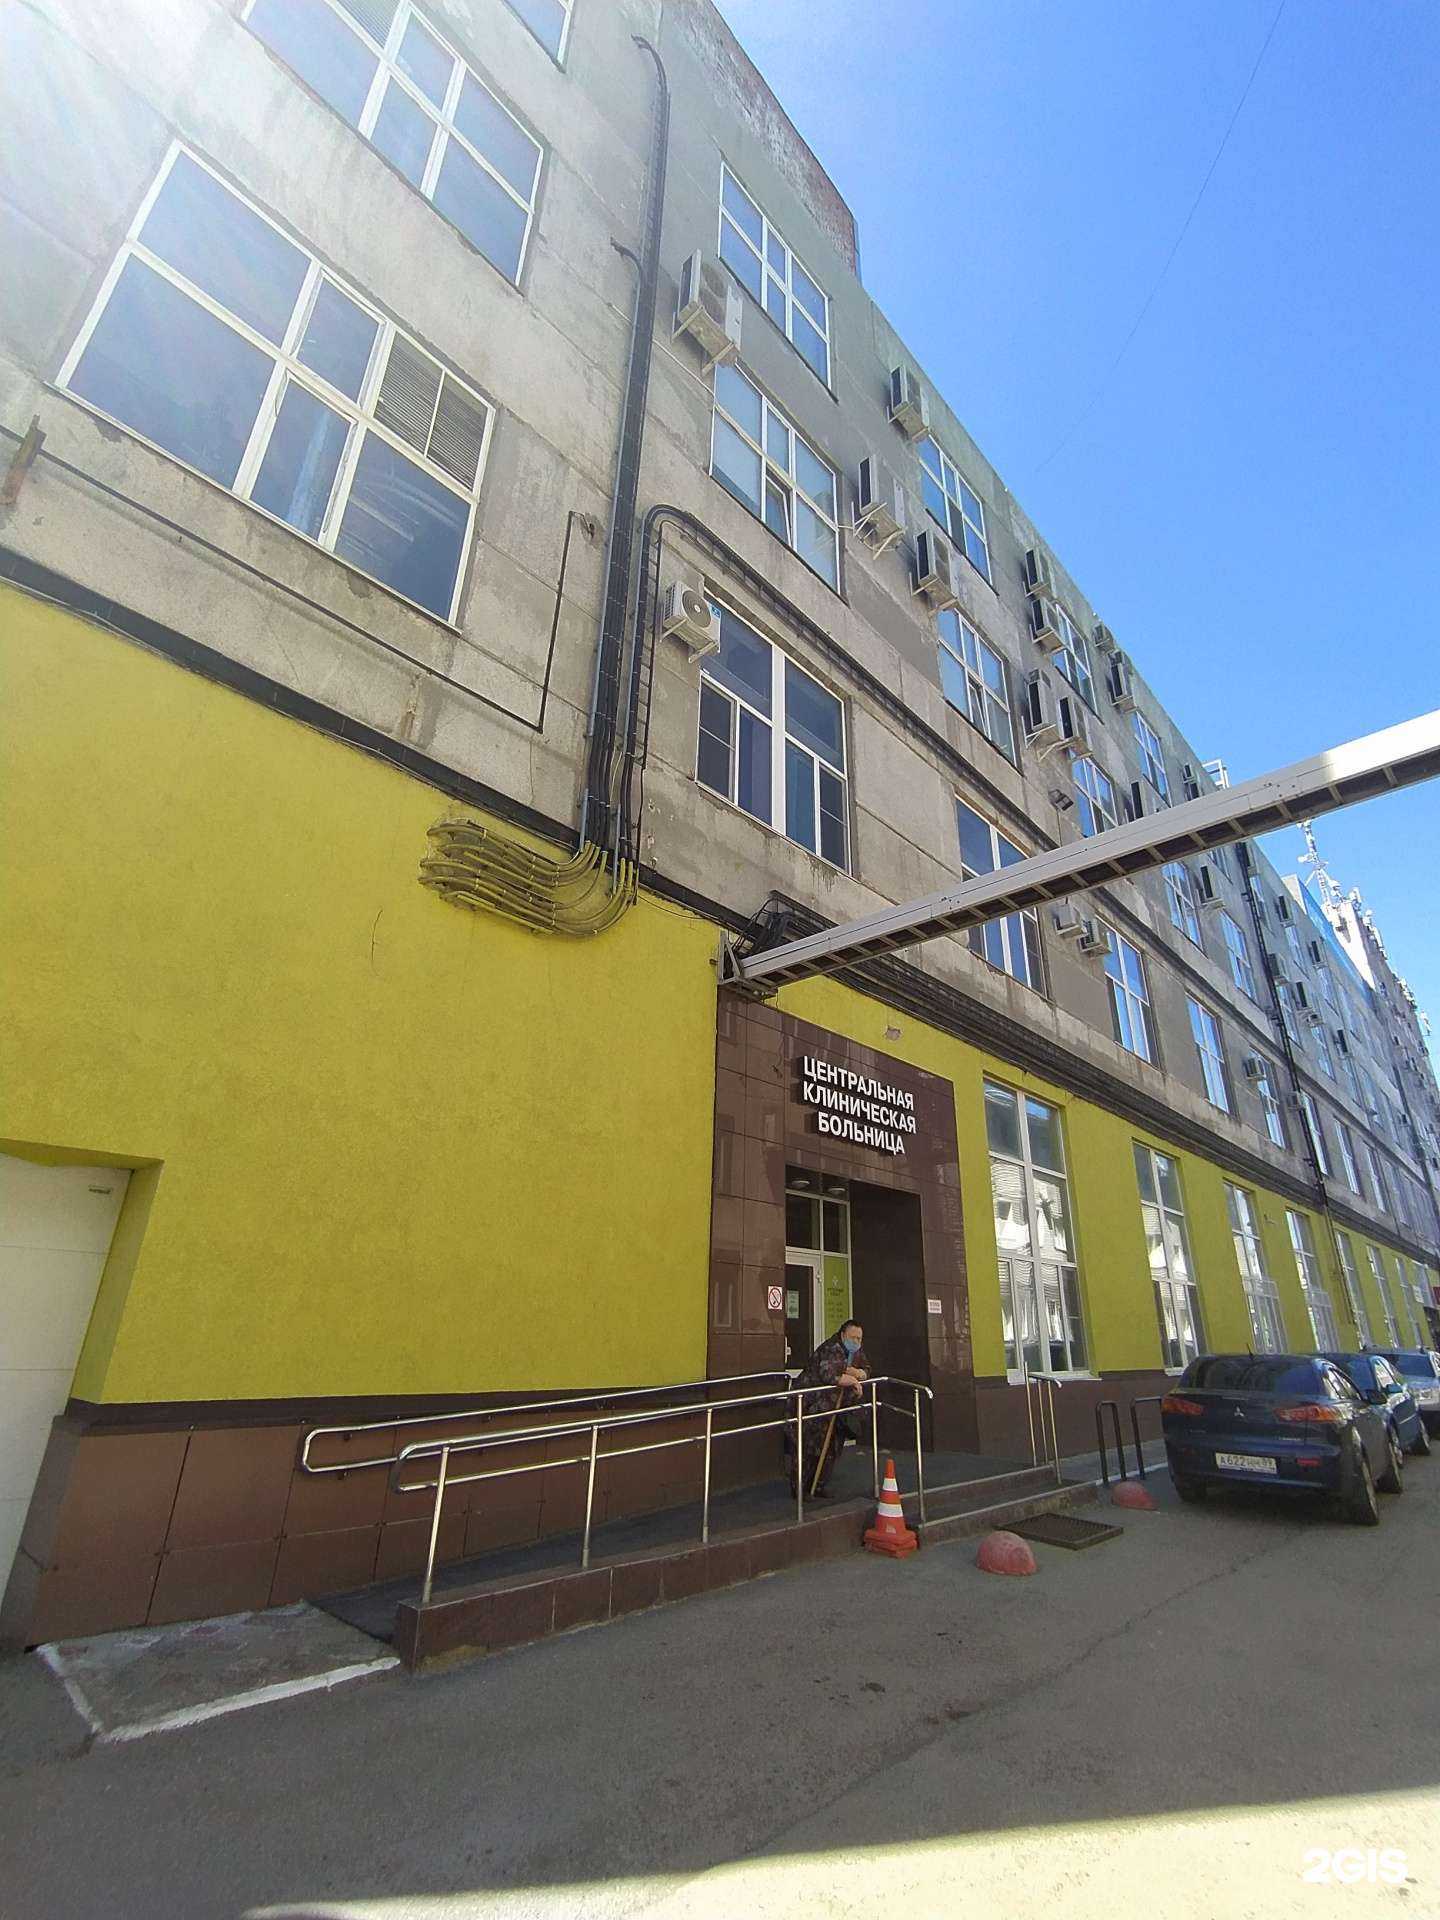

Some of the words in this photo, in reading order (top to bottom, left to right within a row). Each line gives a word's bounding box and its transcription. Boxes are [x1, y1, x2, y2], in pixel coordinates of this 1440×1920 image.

[803, 1081, 917, 1134] КЛИНИЧЕСКАЯ
[804, 1056, 914, 1111] ЦЕНТРАЛЬНАЯ
[818, 1111, 905, 1155] БОЛЬНИЦА
